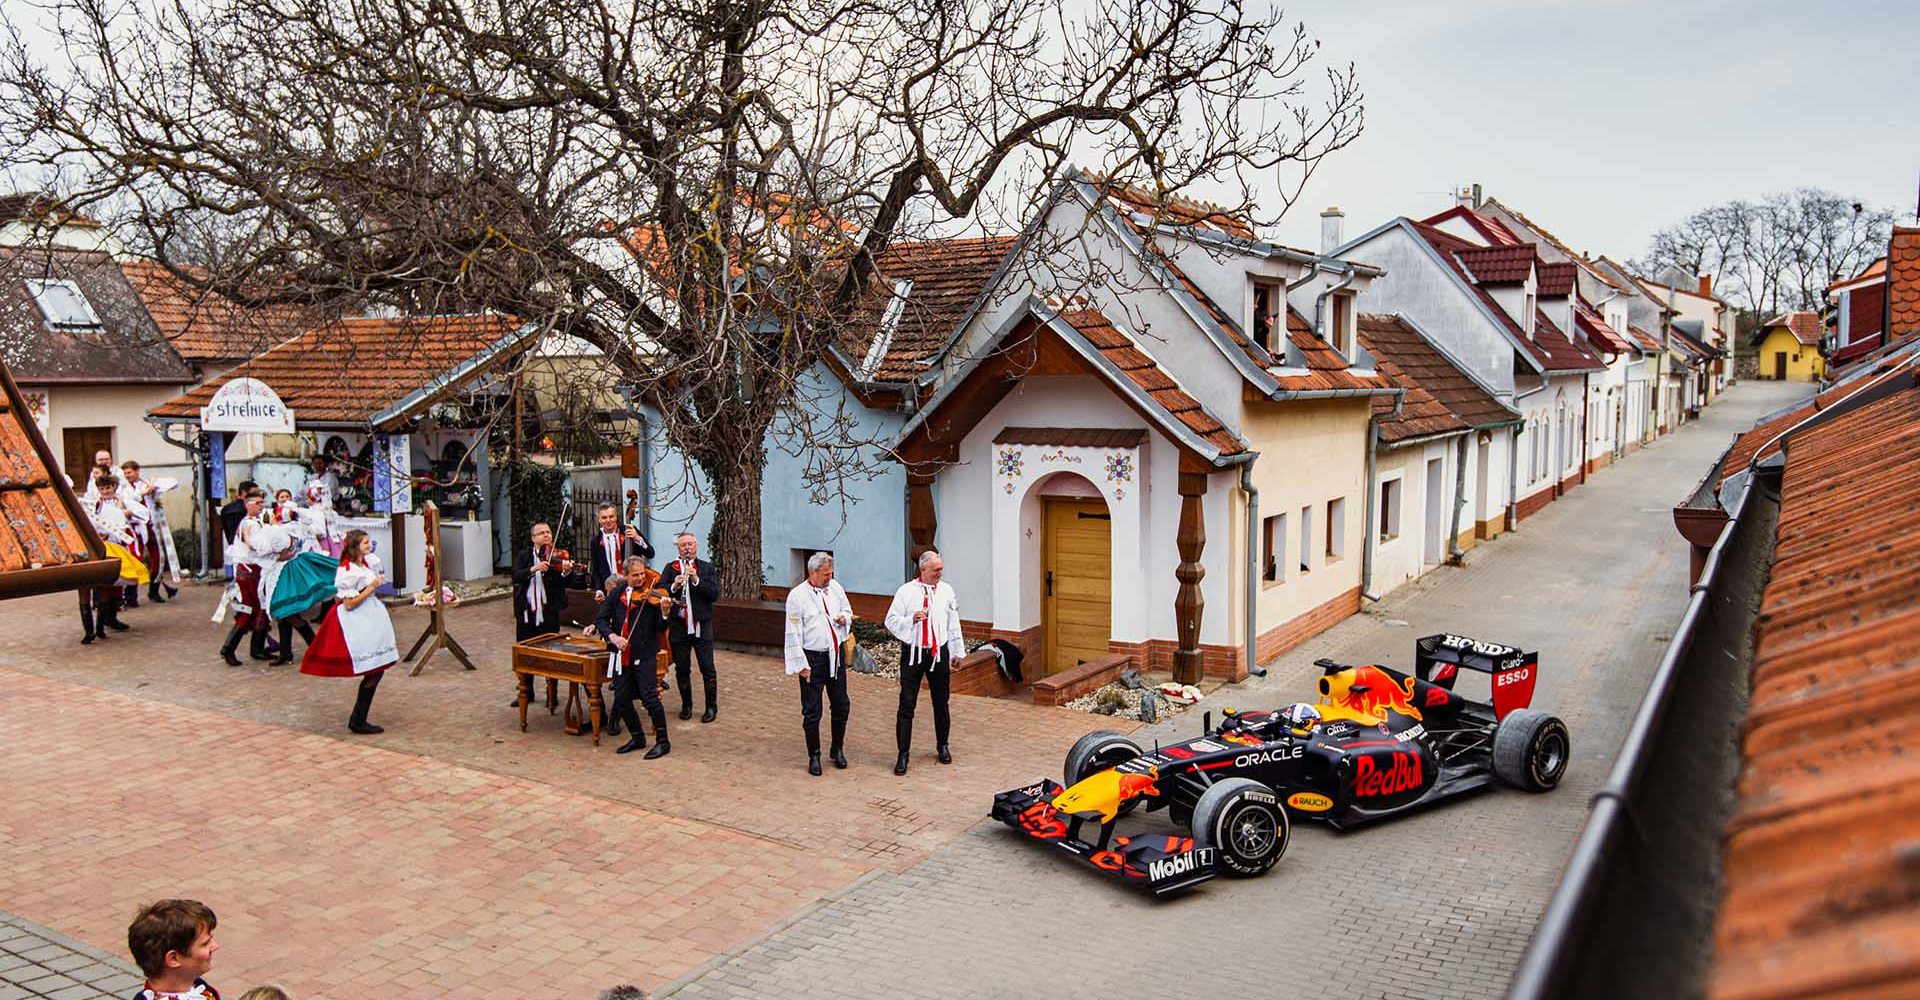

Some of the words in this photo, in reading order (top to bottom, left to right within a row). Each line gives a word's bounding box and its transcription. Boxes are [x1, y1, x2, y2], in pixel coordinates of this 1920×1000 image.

[1497, 668, 1530, 687] ESSO
[1235, 745, 1303, 767] ORACLE
[1298, 796, 1328, 808] RAUCH
[1149, 850, 1194, 882] Mobil
